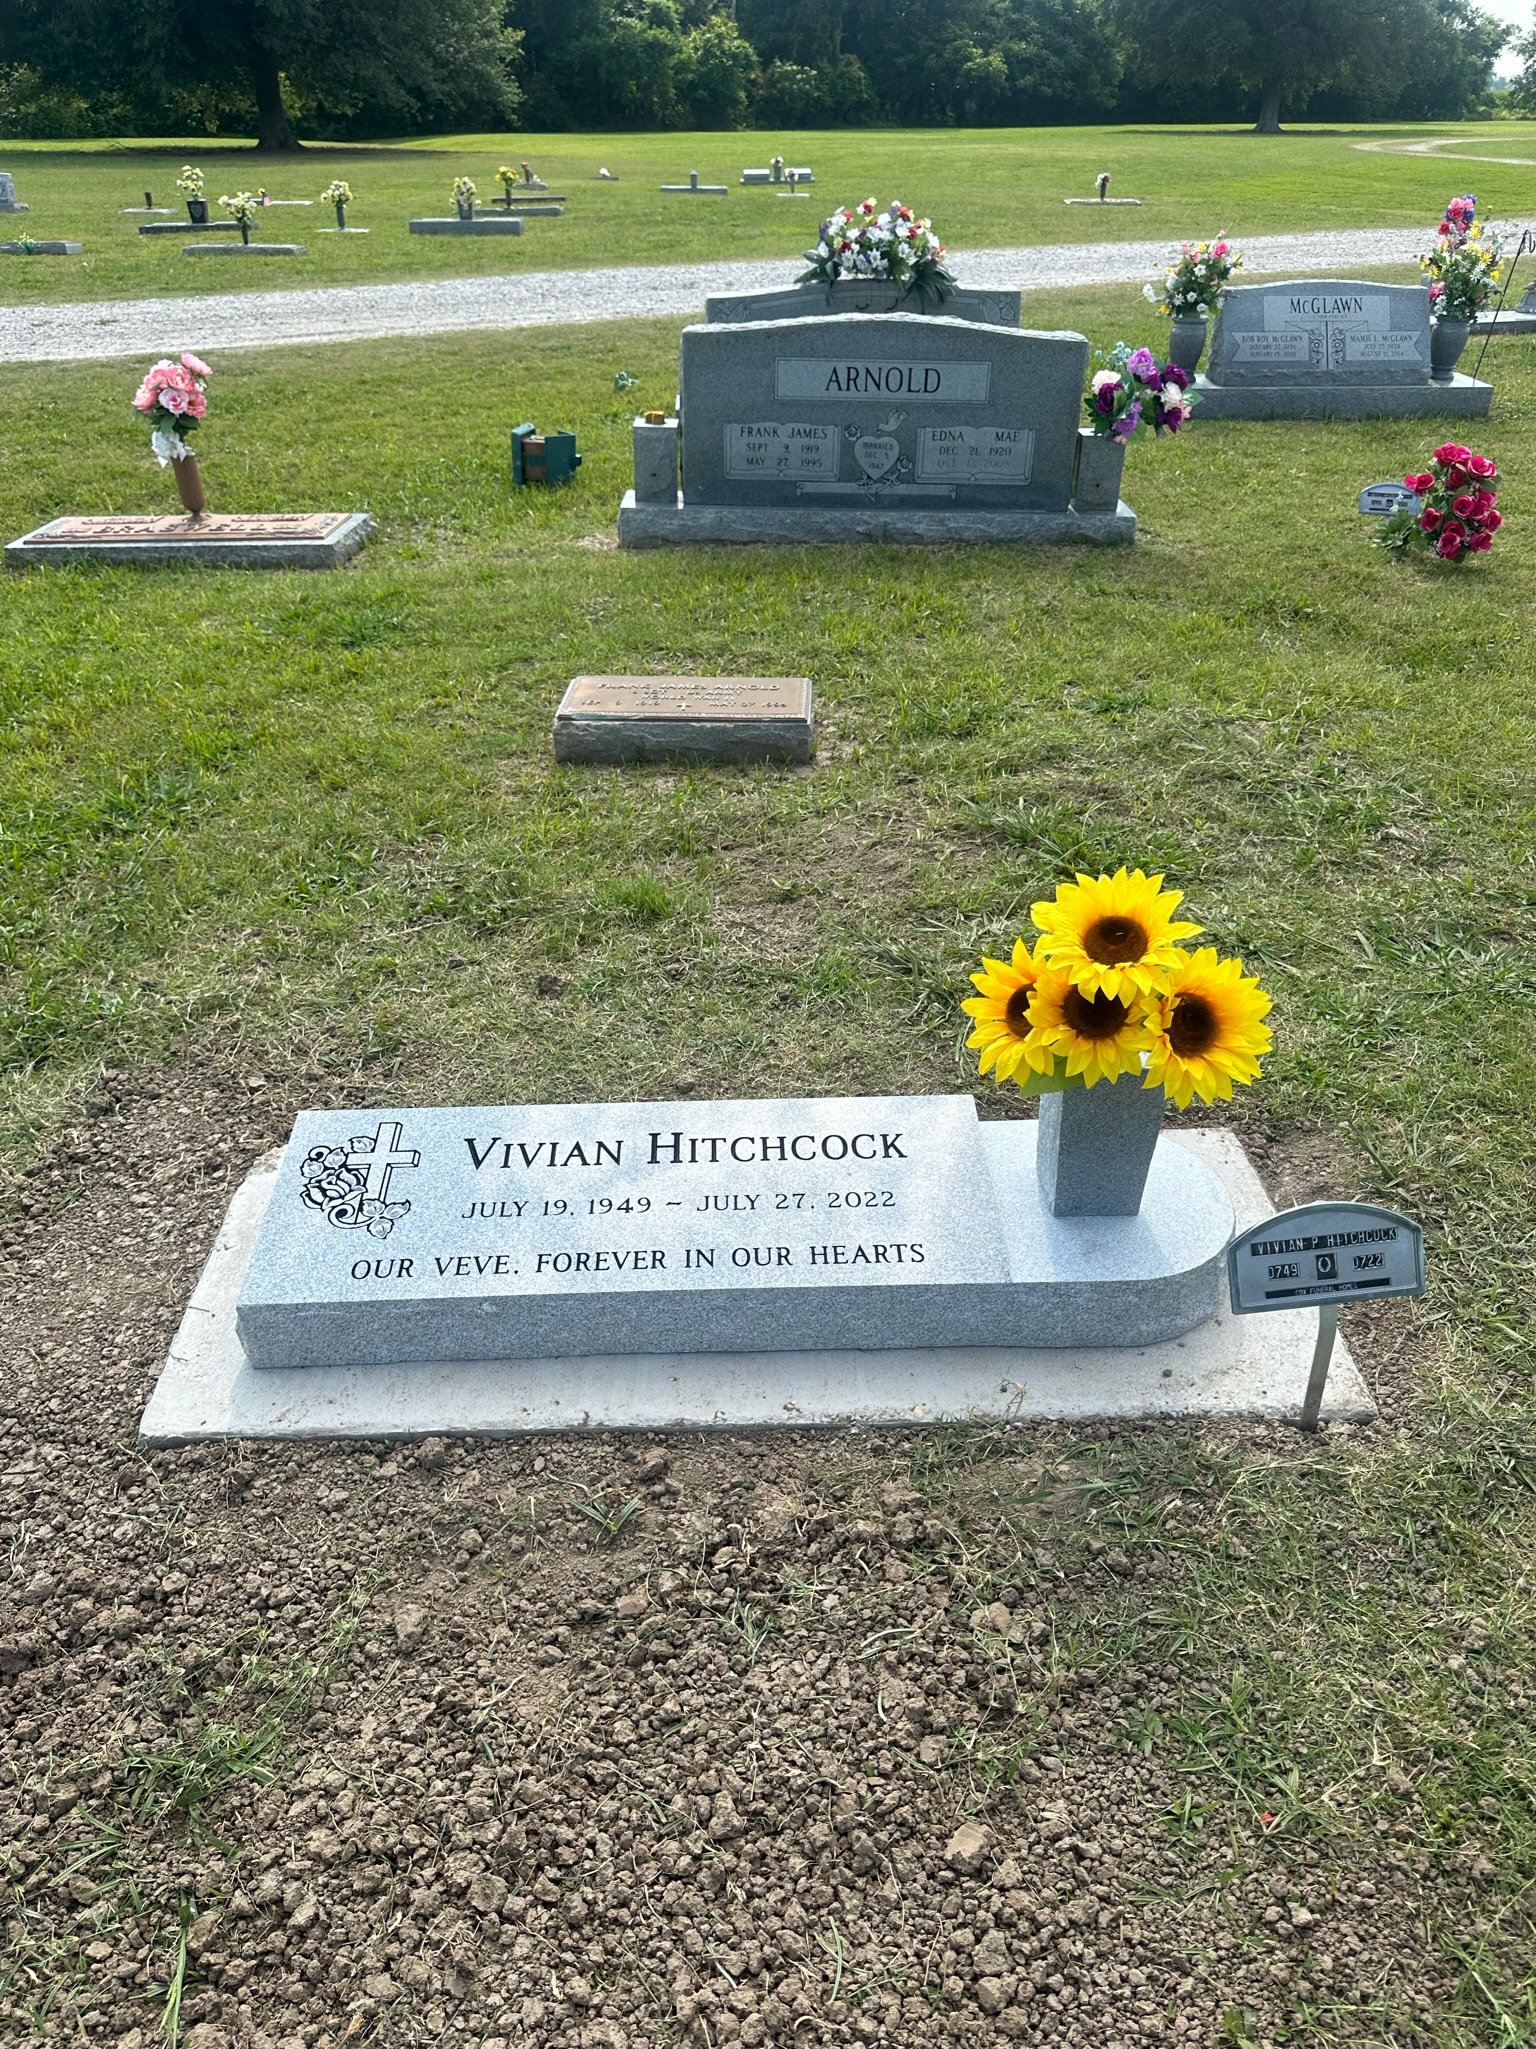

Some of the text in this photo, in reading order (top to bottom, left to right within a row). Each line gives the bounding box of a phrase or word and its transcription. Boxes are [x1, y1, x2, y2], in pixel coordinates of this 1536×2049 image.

[825, 366, 941, 394] ARNOLD
[740, 426, 827, 440] FRANK JAMES
[932, 430, 1019, 442] EDNA MAE
[746, 442, 768, 453] SEPT
[939, 446, 958, 456] DEC
[989, 446, 1012, 457] 1920
[746, 457, 765, 466] MAY
[464, 1131, 908, 1170] VIVIAN HITCHCOCK
[462, 1200, 530, 1219] JULY
[588, 1197, 652, 1215] 1949
[697, 1194, 761, 1212] JULY
[827, 1191, 896, 1208] 2022
[1257, 1227, 1395, 1255] VIVIAN P HITCHCOCK
[351, 1258, 415, 1280] OUR
[535, 1249, 667, 1274] FOREVER
[684, 1248, 716, 1268] IN
[731, 1246, 793, 1268] OUR
[810, 1243, 926, 1265] HEARTS
[1310, 1284, 1336, 1294] FUNERAL
